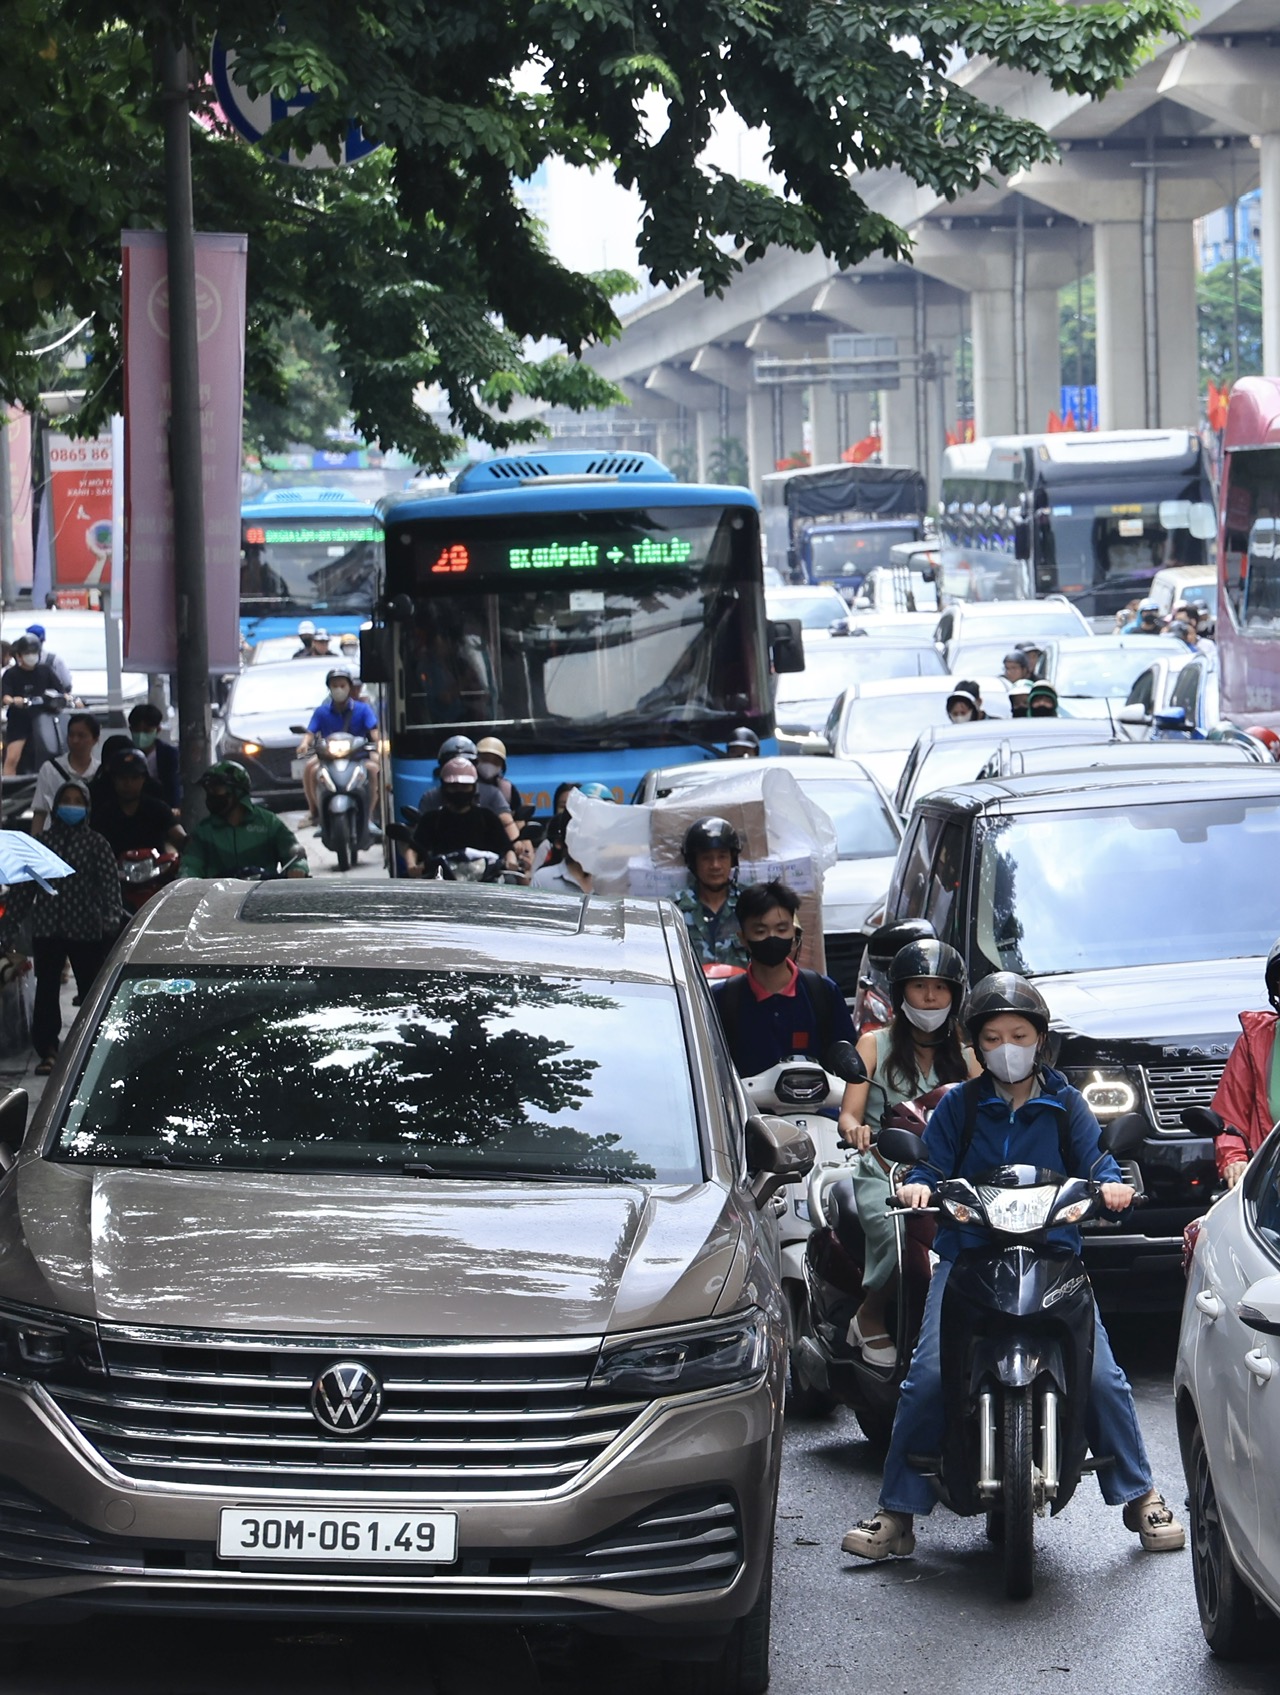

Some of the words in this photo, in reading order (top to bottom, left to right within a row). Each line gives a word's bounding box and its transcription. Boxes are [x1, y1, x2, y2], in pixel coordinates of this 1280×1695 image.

[91, 448, 109, 461] 86
[1004, 1245, 1035, 1253] HONDA
[240, 1518, 436, 1552] 30M-061.49
